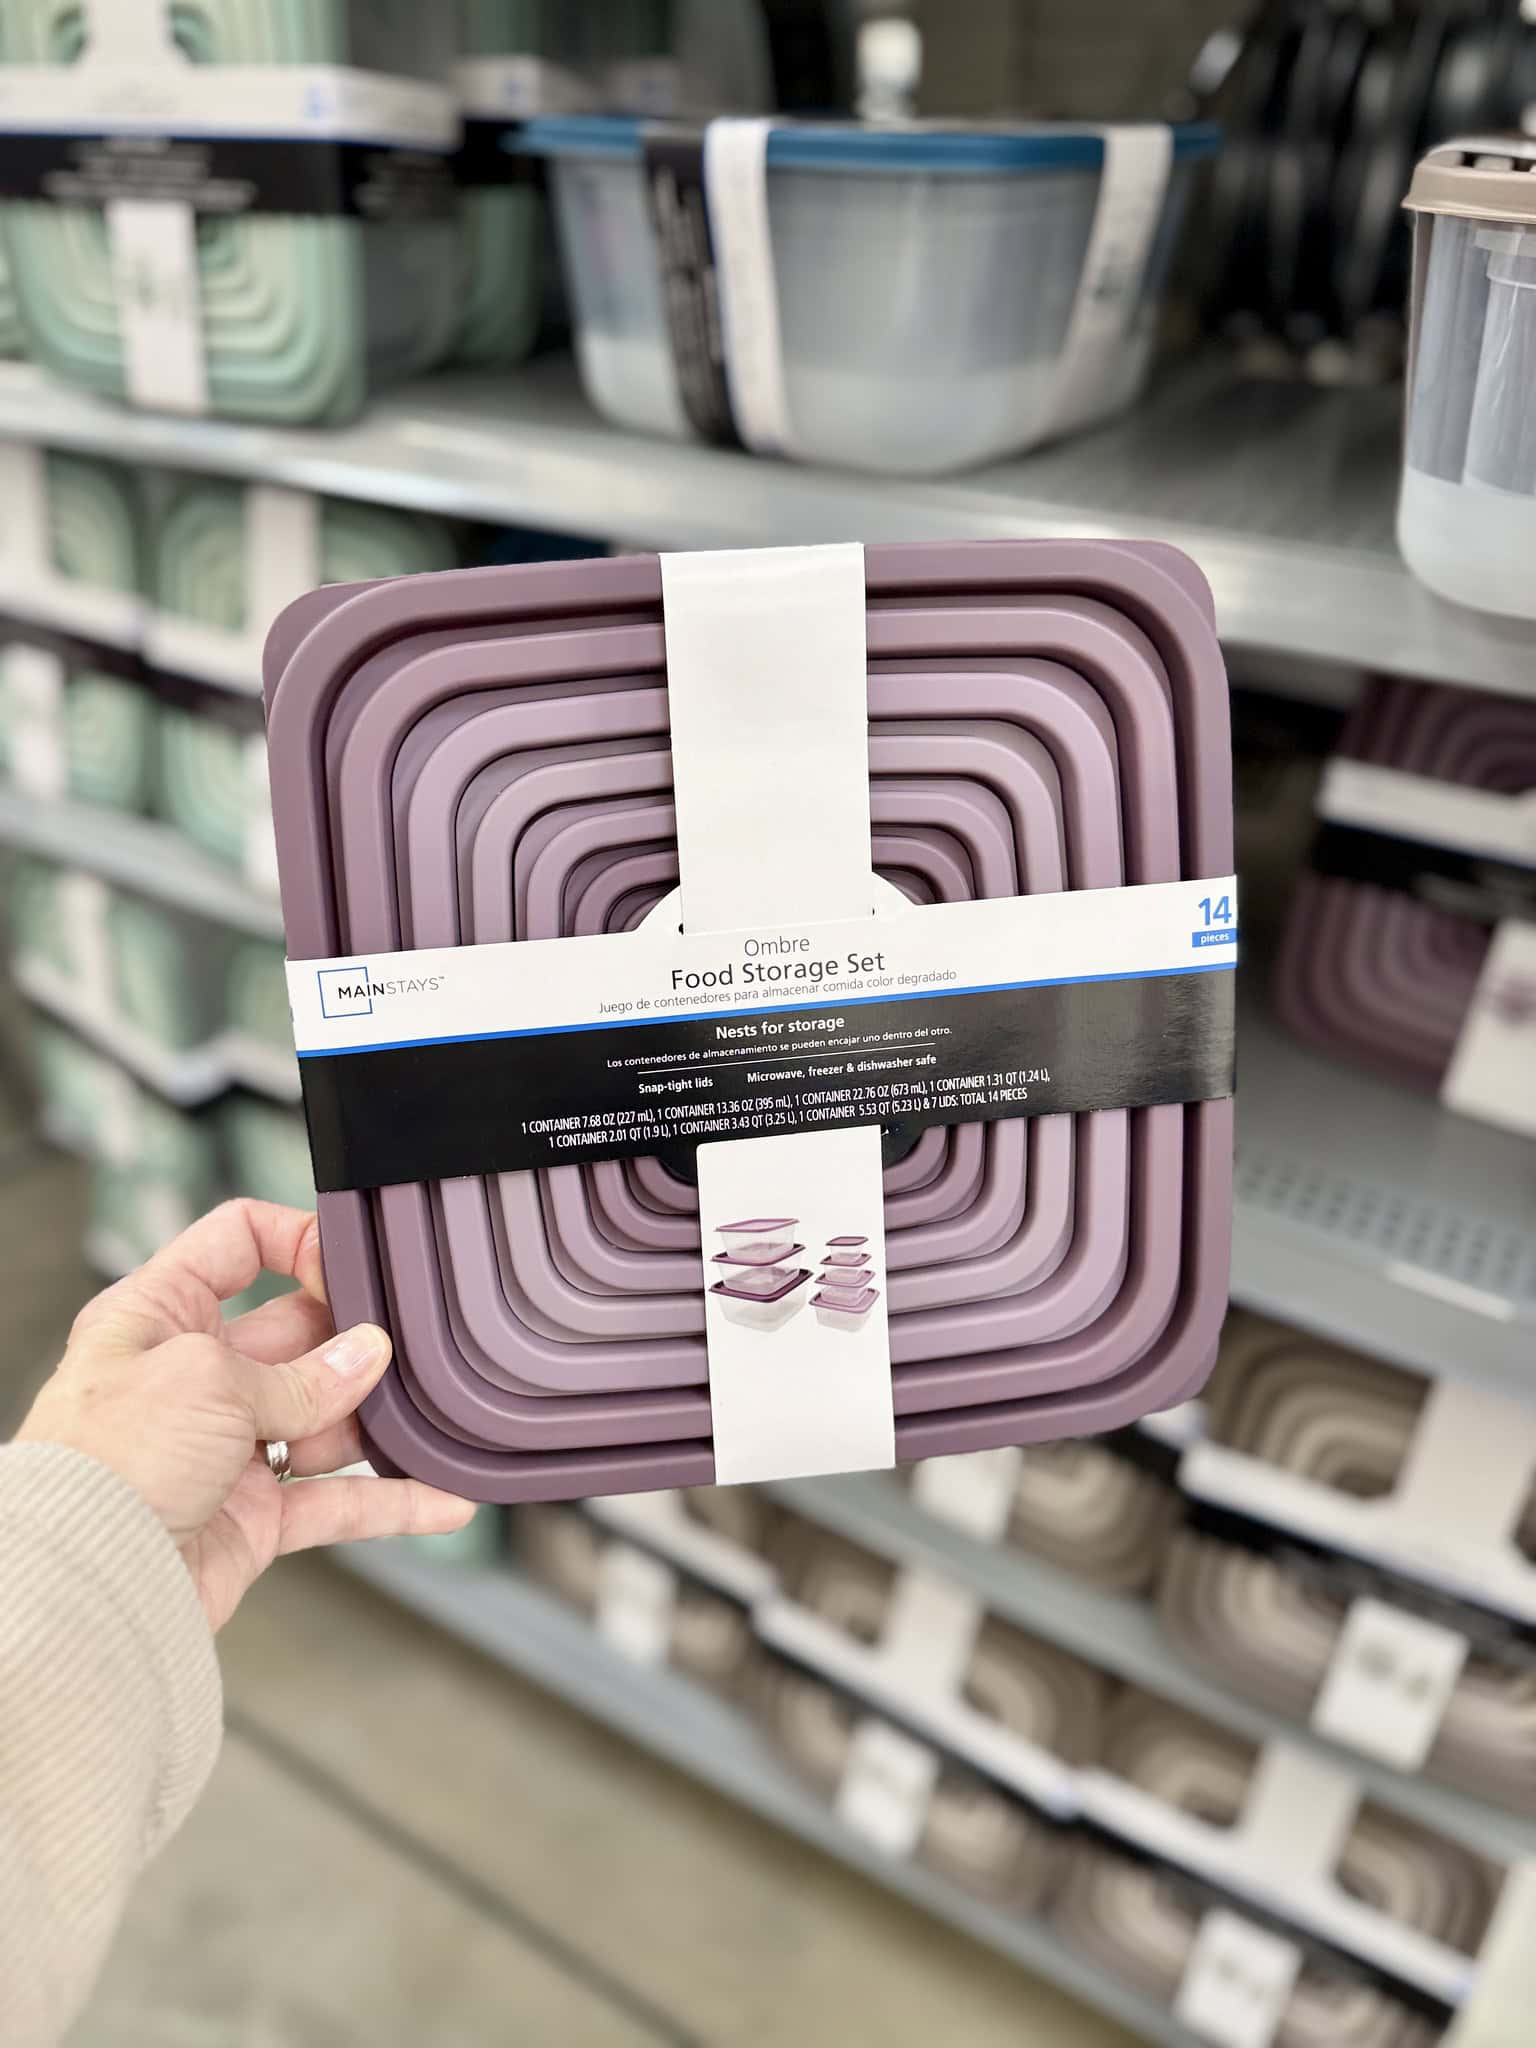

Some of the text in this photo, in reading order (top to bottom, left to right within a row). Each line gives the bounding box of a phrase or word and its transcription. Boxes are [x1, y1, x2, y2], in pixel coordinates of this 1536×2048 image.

[1198, 895, 1232, 926] 14
[744, 935, 810, 957] Ombre
[1200, 932, 1229, 945] pieces
[671, 952, 886, 990] Food Storage Set
[599, 969, 957, 1014] Juego de contenedores para almacenar comida color degradado
[716, 1017, 845, 1040] Nests for storage
[607, 1026, 952, 1068] Los contenedores de almacenamiento se pueden encajar uno dentro del otro.
[747, 1054, 937, 1083] Microwave, freezer & dishwasher safe
[521, 1068, 1050, 1134] 1 CONTAINER 7.68 OZ (227 mL), 1 CONTAINER 13.36 OZ (395 mL), 1 CONTAINER 22.76 OZ (673 mL), 1 CONTAINER 1.31 QT (1.24 L),
[638, 1077, 714, 1094] Snap-tight lids
[549, 1137, 554, 1148] 1
[556, 1131, 608, 1148] CONTAINER
[609, 1129, 627, 1142] 2.01
[629, 1128, 642, 1141] QT
[643, 1126, 659, 1140] (1.9
[661, 1124, 671, 1138] L),
[673, 1124, 678, 1135] 1
[680, 1119, 730, 1135] CONTAINER
[732, 1116, 750, 1130] 3.43
[751, 1115, 764, 1128] QT
[765, 1113, 786, 1127] (3.25
[787, 1111, 797, 1125] L),
[799, 1111, 804, 1122] 1
[806, 1105, 855, 1121] CONTAINER
[859, 1103, 877, 1116] 5.53
[878, 1101, 891, 1115] QT
[891, 1099, 912, 1114] (5.23
[914, 1098, 921, 1112] L)
[923, 1097, 930, 1109] &
[931, 1097, 936, 1109] 7
[960, 1091, 986, 1105] TOTAL
[988, 1090, 999, 1102] 14
[1000, 1087, 1028, 1101] PIECES
